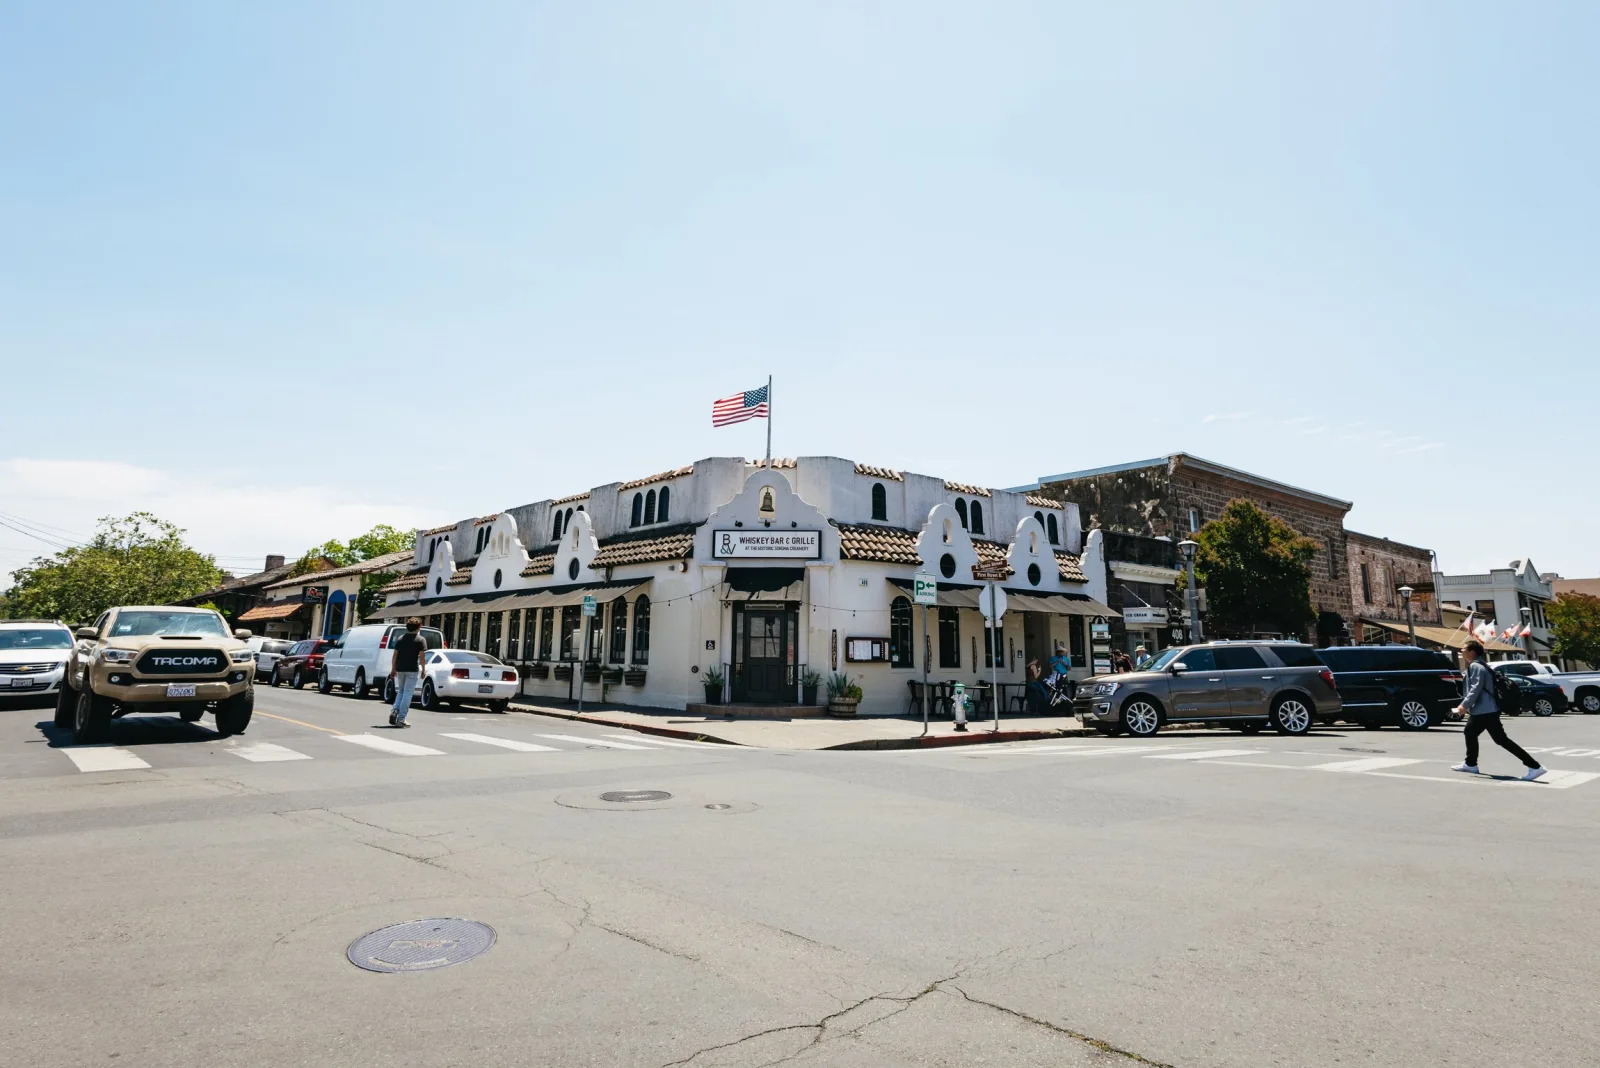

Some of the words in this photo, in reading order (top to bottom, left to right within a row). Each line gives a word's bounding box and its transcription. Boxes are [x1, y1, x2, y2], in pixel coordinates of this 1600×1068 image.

[723, 533, 731, 545] B
[739, 536, 769, 544] WHISKEY
[770, 537, 784, 545] BAR
[785, 537, 790, 545] &
[791, 537, 815, 545] GRILLE
[1172, 628, 1183, 640] 408
[152, 657, 218, 665] TACOMA
